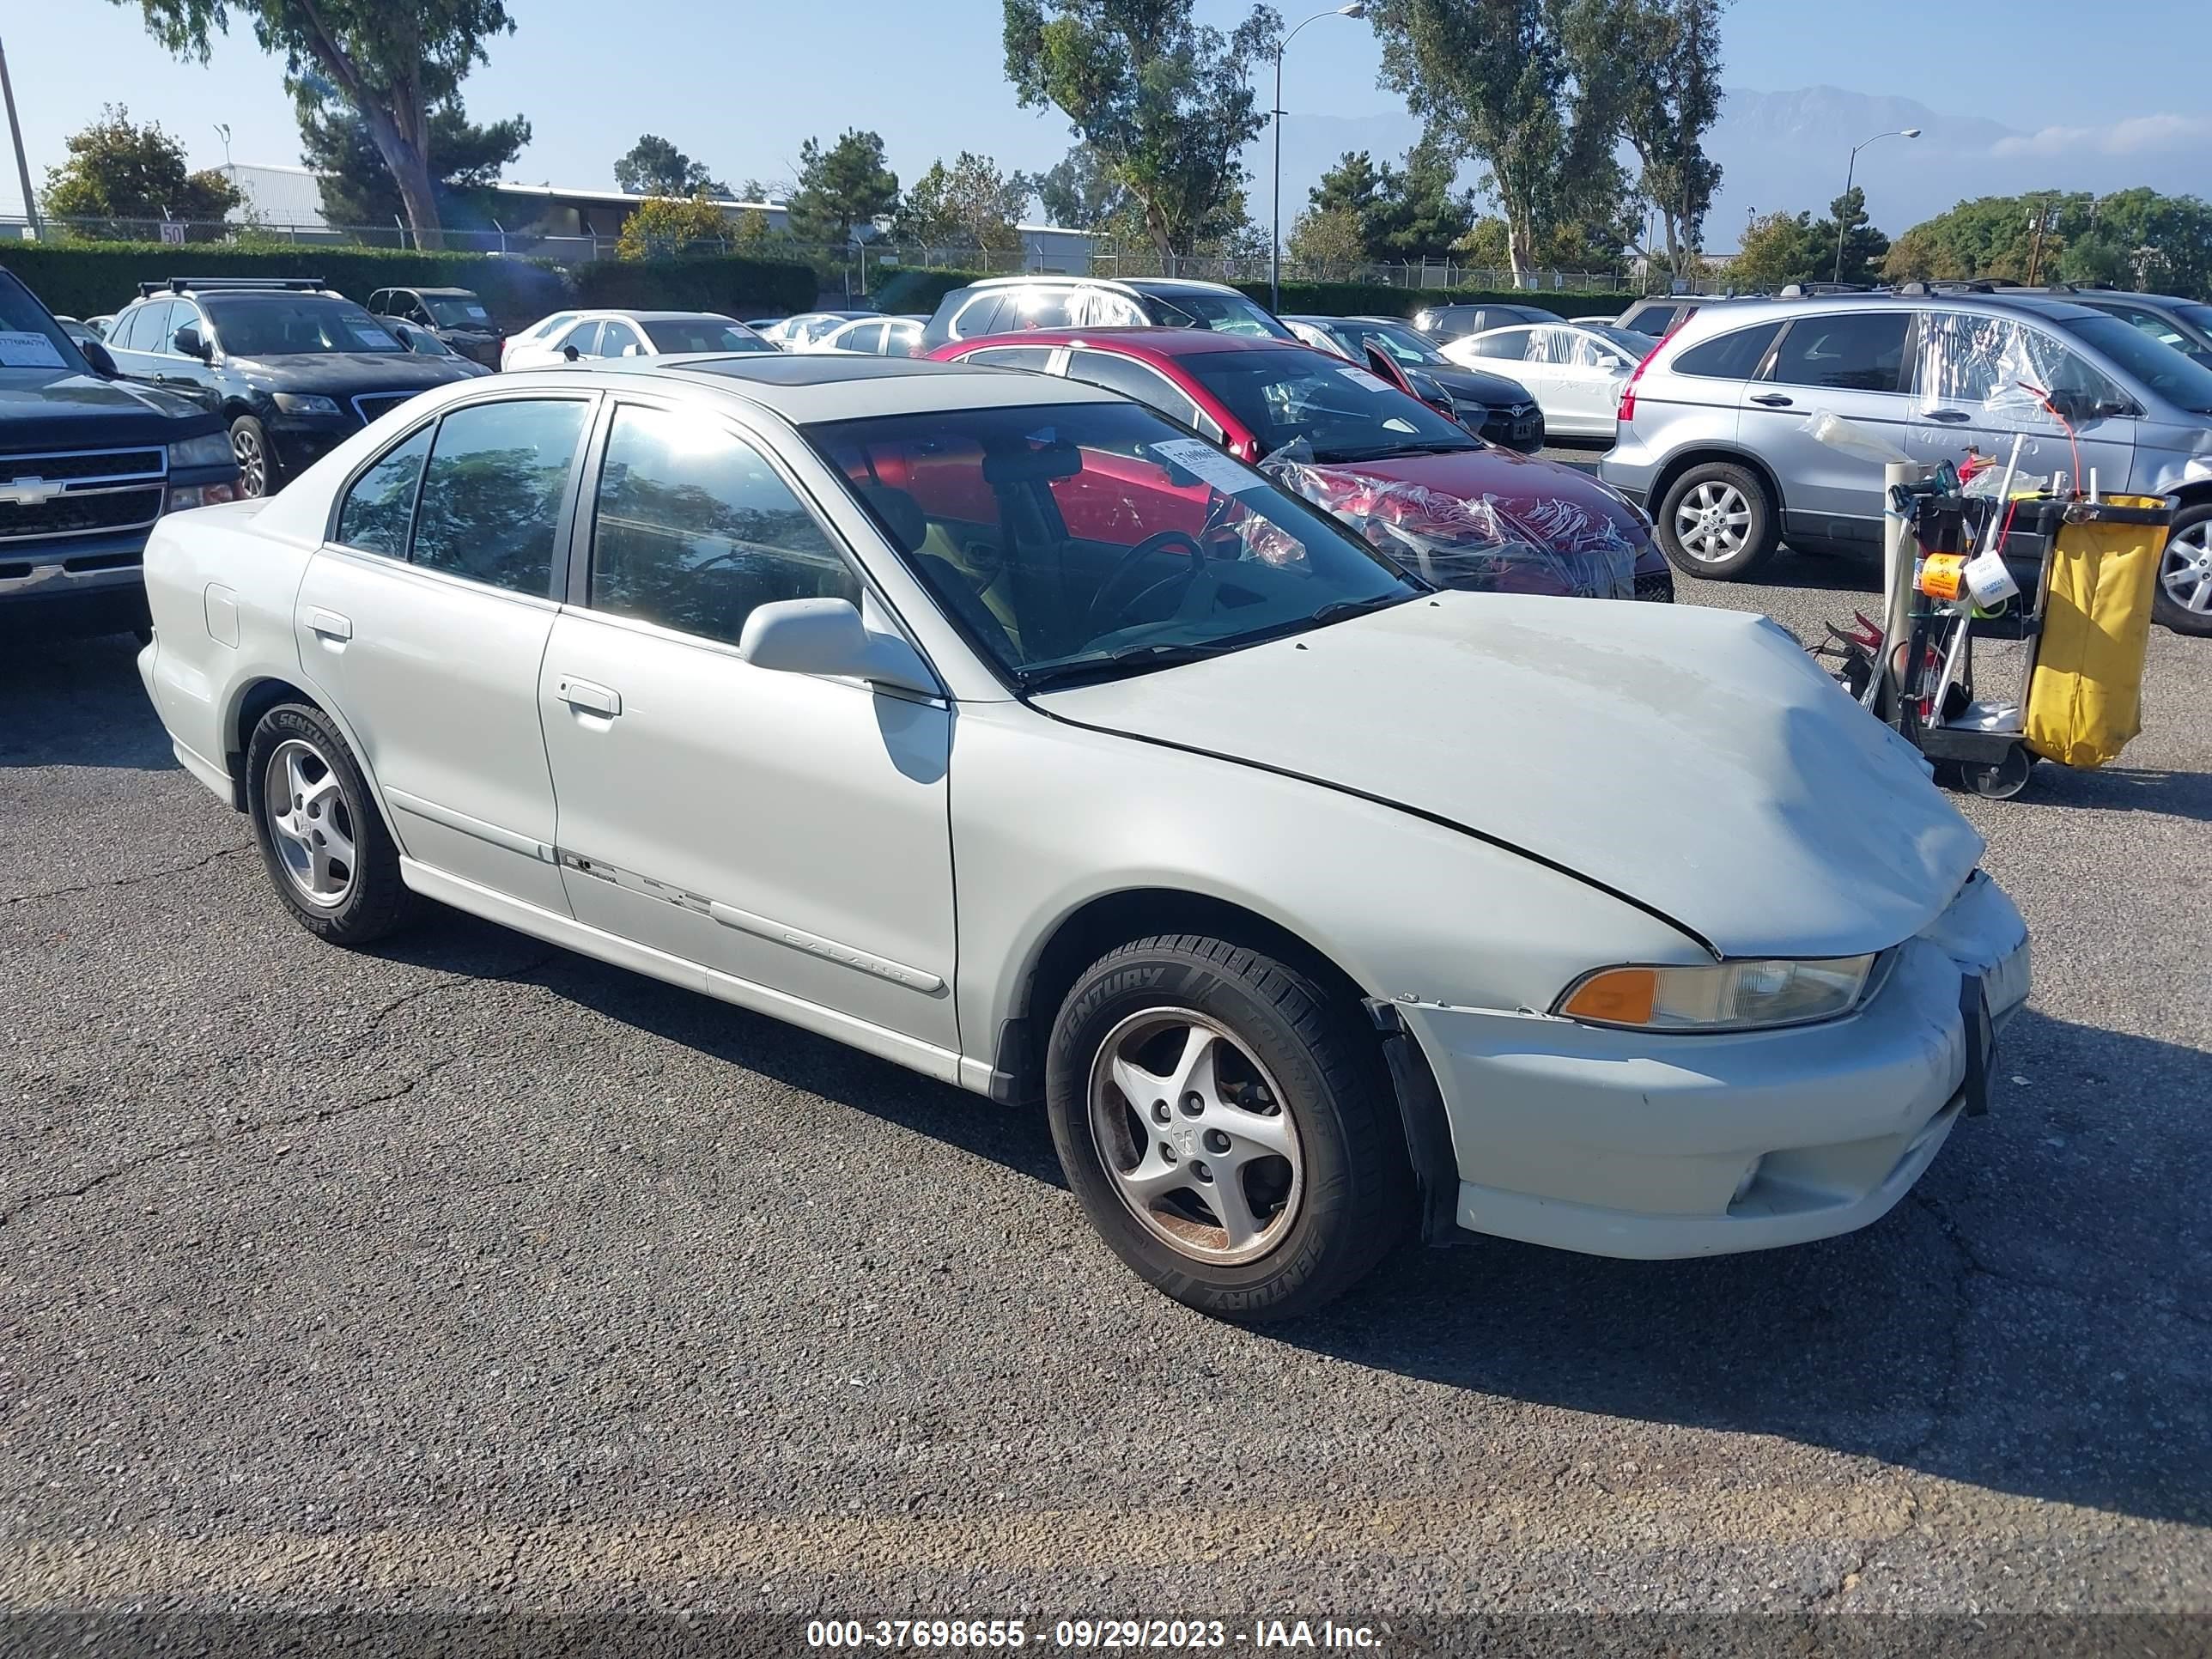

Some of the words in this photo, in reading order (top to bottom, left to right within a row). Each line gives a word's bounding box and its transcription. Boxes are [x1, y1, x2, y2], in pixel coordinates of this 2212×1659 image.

[163, 225, 182, 243] 50
[783, 933, 911, 981] GALANT
[1057, 967, 1167, 1060] SENTURY
[1203, 1228, 1328, 1311] SENTURY
